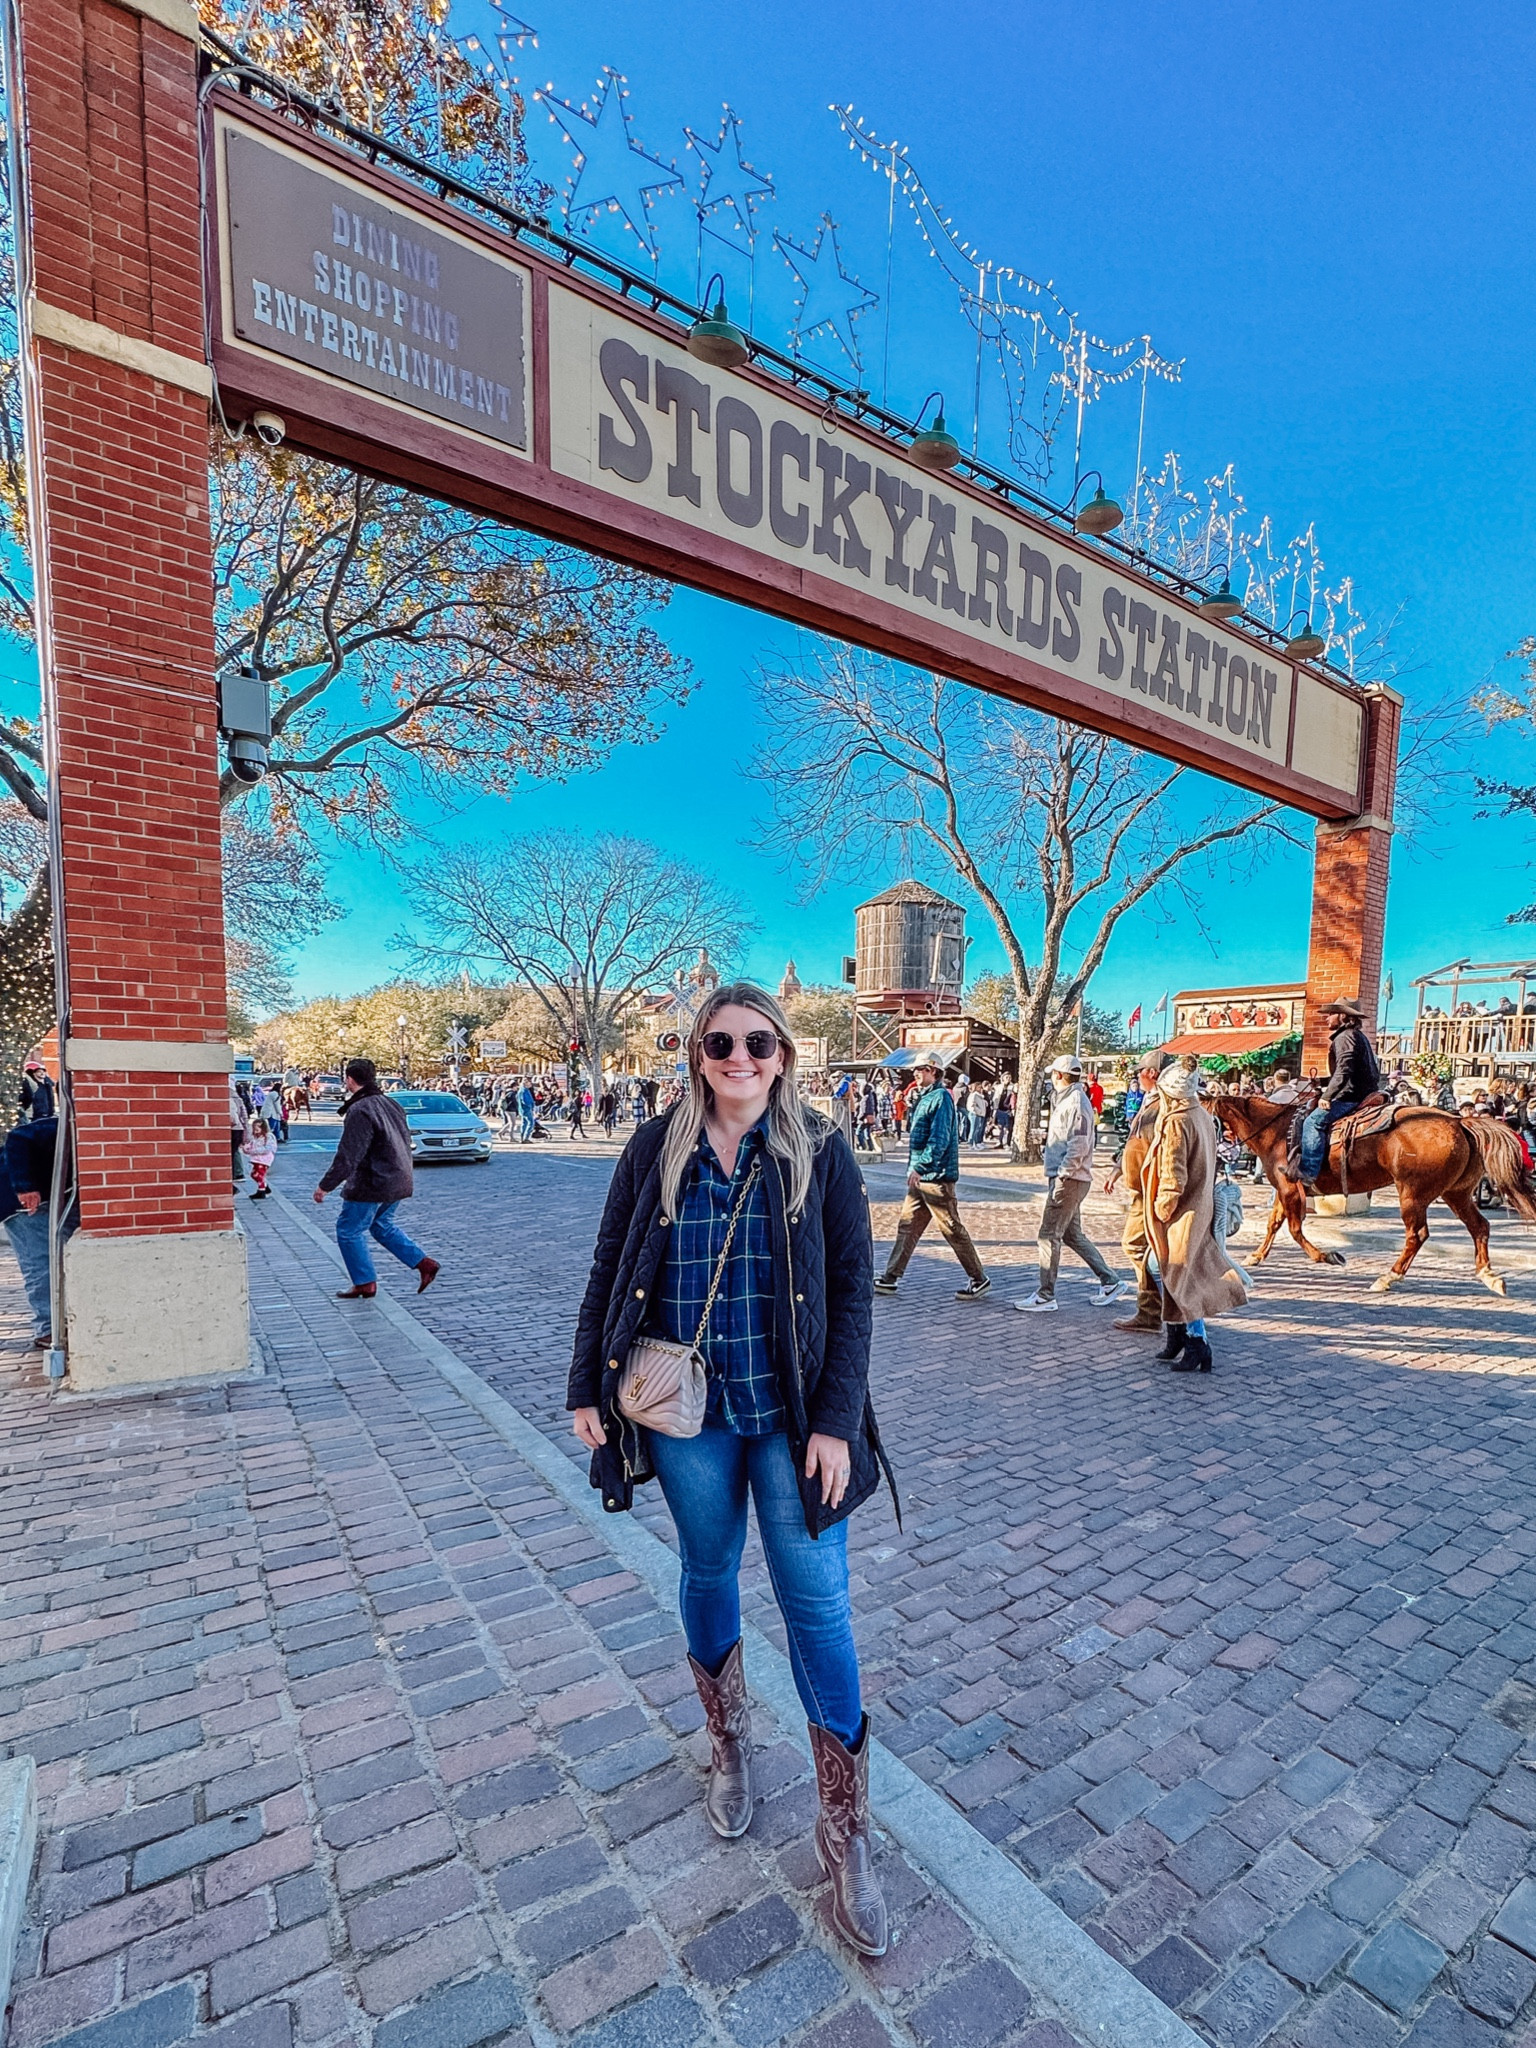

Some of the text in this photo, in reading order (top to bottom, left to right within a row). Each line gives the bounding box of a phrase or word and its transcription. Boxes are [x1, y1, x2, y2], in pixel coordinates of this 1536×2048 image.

[332, 204, 441, 290] DINING
[312, 250, 460, 352] SHOPPING
[252, 278, 512, 423] ENTERTAINMENT
[599, 338, 1278, 749] STOCKYARDS STATION
[668, 984, 697, 1015] CROSSING
[1194, 1010, 1280, 1028] MAZE
